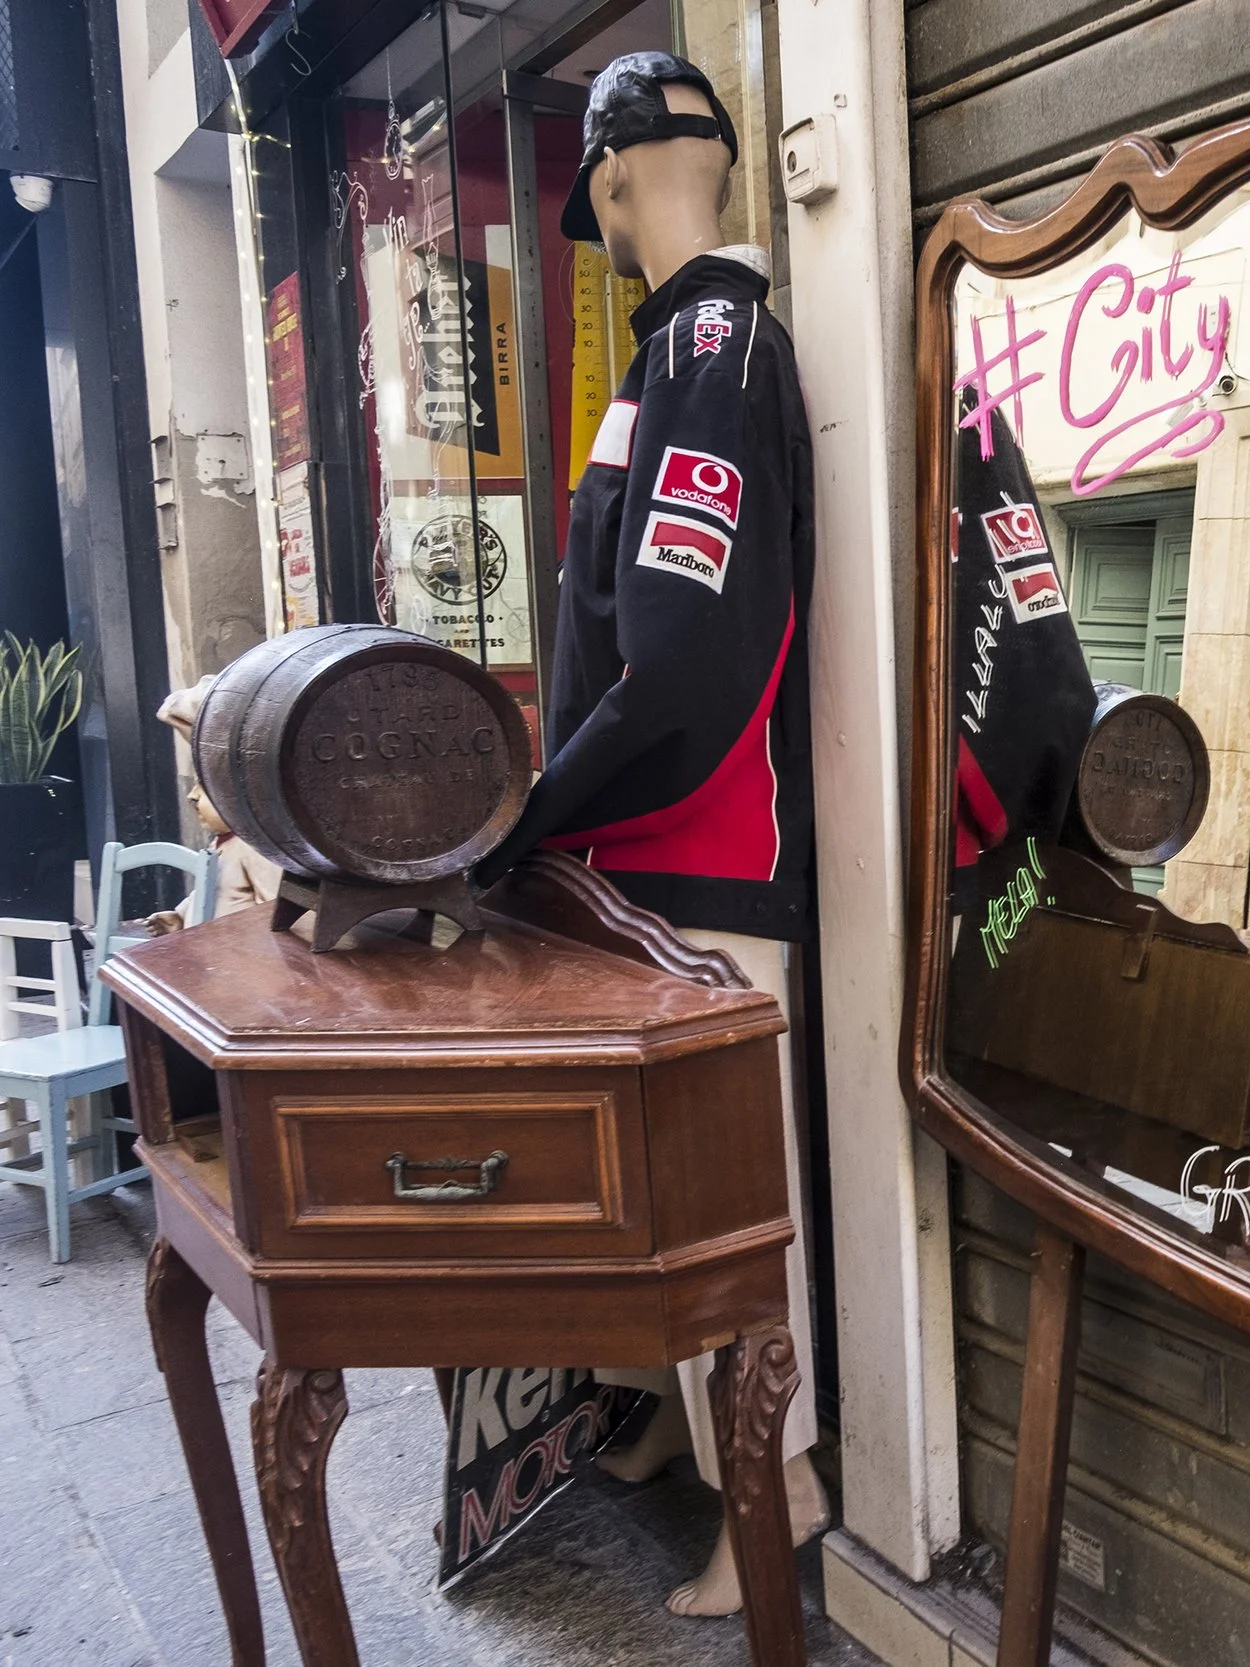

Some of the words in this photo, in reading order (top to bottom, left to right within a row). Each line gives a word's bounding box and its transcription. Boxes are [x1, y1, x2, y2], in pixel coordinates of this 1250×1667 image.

[496, 322, 510, 386] BIRRA
[952, 249, 1230, 490] #City
[671, 487, 732, 516] vodafone
[418, 518, 498, 551] PYER'S
[656, 546, 715, 579] Marlboro
[438, 637, 505, 649] GARETES
[313, 726, 495, 762] COGNAC
